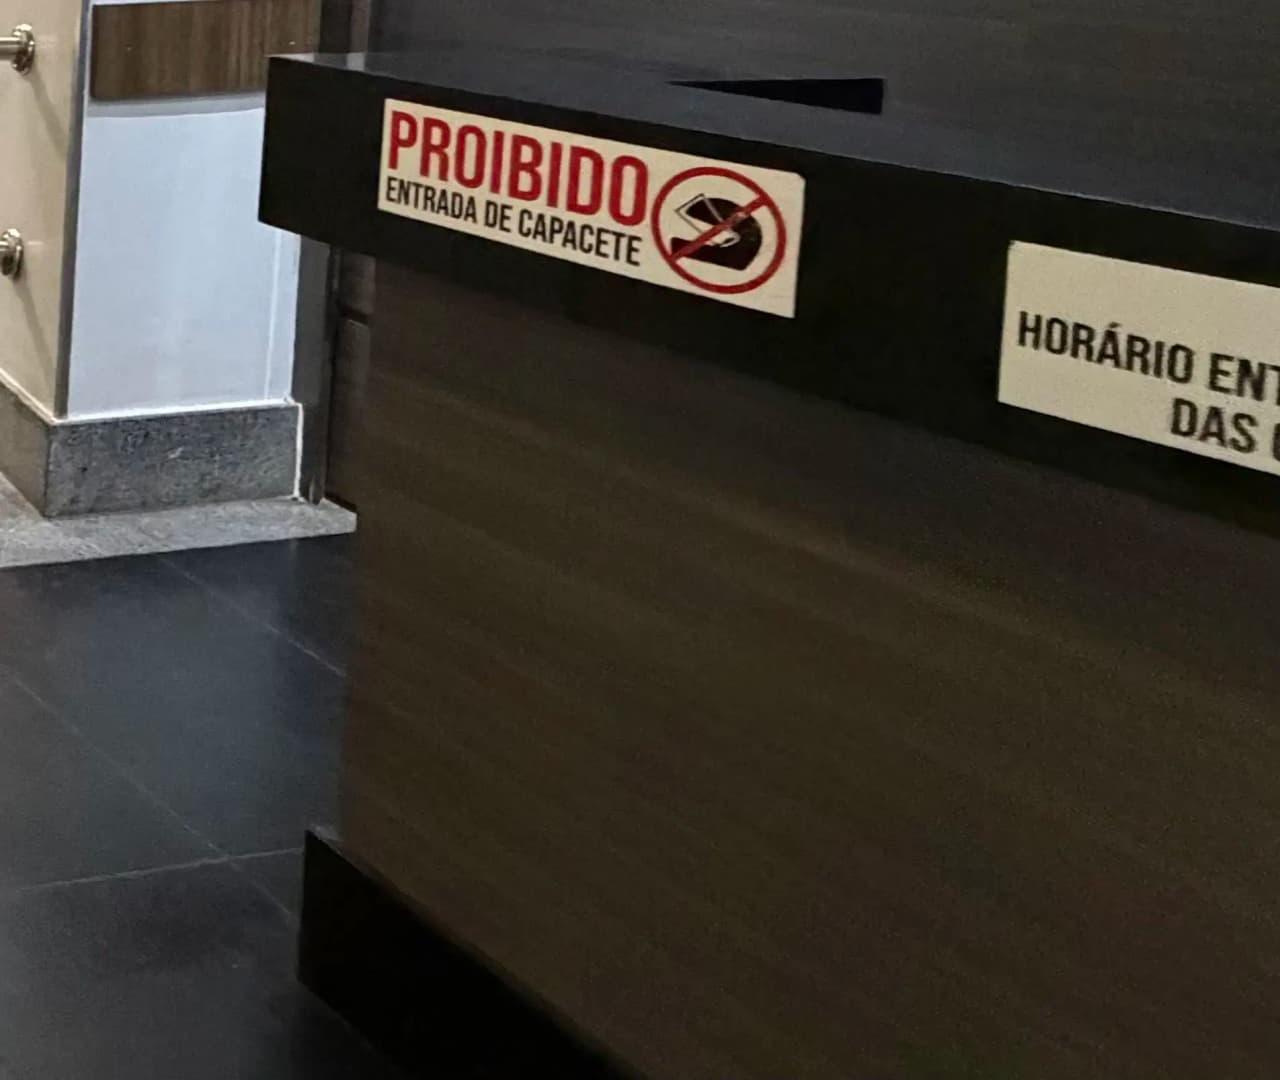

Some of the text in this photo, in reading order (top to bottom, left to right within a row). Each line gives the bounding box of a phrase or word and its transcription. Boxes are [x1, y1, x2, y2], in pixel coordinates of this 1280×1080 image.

[388, 110, 649, 226] PROIBIDO
[386, 176, 643, 267] ENTRADA DE CAPACETE
[1018, 311, 1194, 384] HORÁRIO
[1170, 398, 1258, 454] DAS
